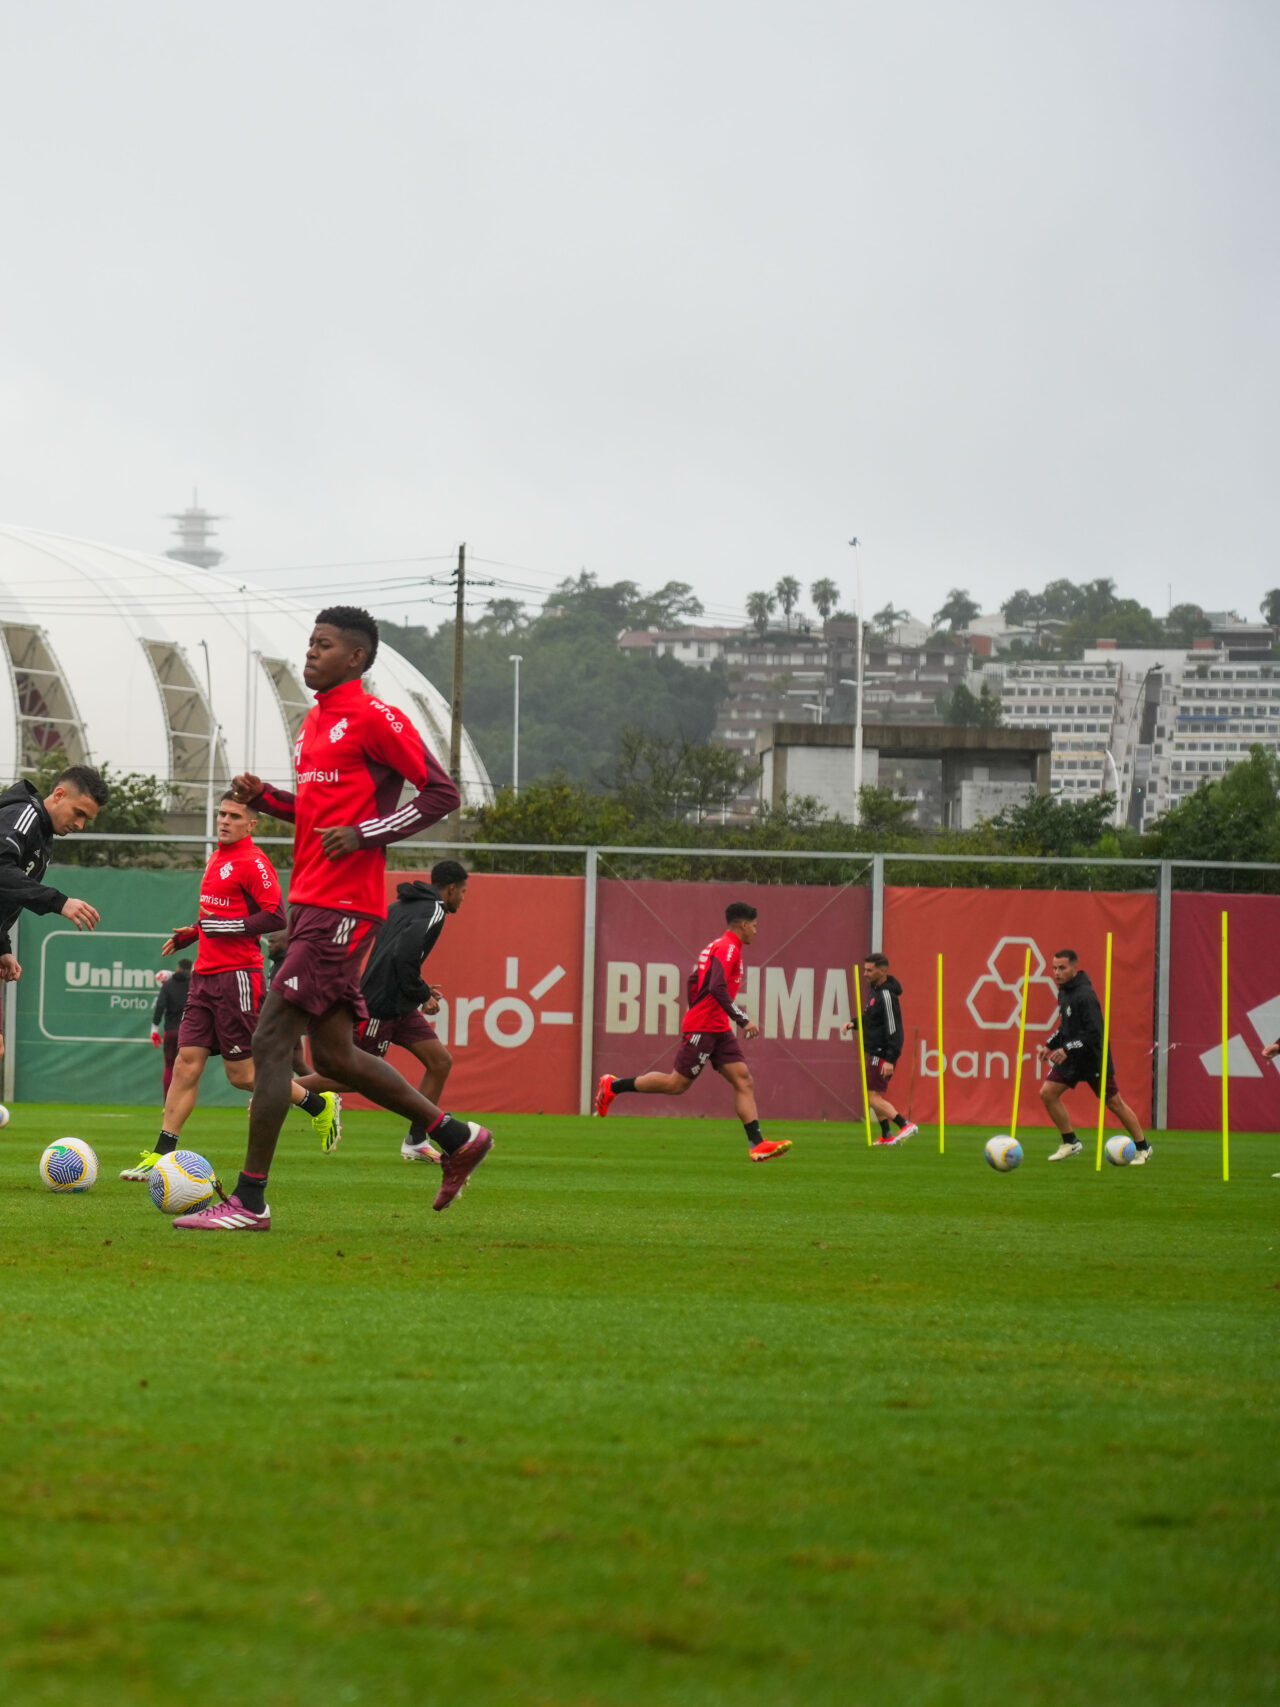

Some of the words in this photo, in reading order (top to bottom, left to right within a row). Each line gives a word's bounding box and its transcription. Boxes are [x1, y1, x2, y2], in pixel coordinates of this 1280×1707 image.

[255, 858, 269, 880] vero
[66, 961, 161, 988] Unim
[111, 996, 148, 1009] Porto
[606, 961, 853, 1041] BRHMA
[417, 996, 534, 1048] aro
[921, 1040, 1056, 1080] banri
